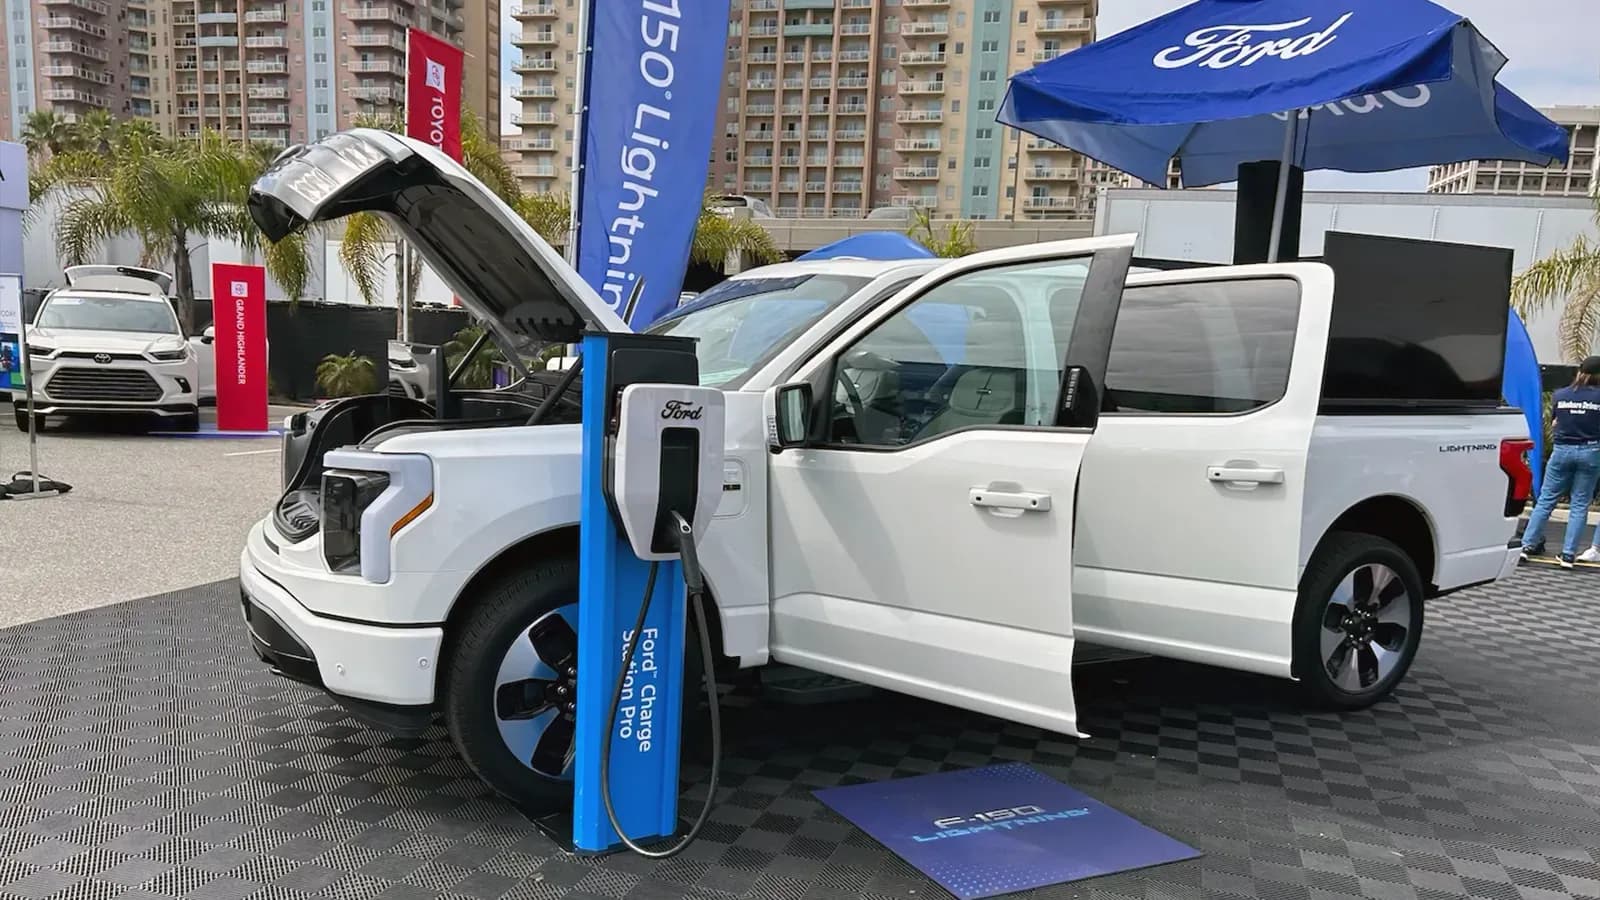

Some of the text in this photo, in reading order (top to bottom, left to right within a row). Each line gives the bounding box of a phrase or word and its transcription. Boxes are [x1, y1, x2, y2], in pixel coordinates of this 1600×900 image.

[1152, 11, 1354, 69] Ford
[430, 96, 445, 151] TOYO
[601, 103, 671, 313] Lightnin
[235, 299, 247, 385] GRAND HIGHLANDER
[661, 400, 703, 420] Ford
[1439, 443, 1498, 454] LIGHTNING
[619, 706, 636, 739] Pro
[637, 684, 657, 752] Charge
[912, 809, 1089, 842] LIGHTNING
[933, 805, 1046, 829] F-150
